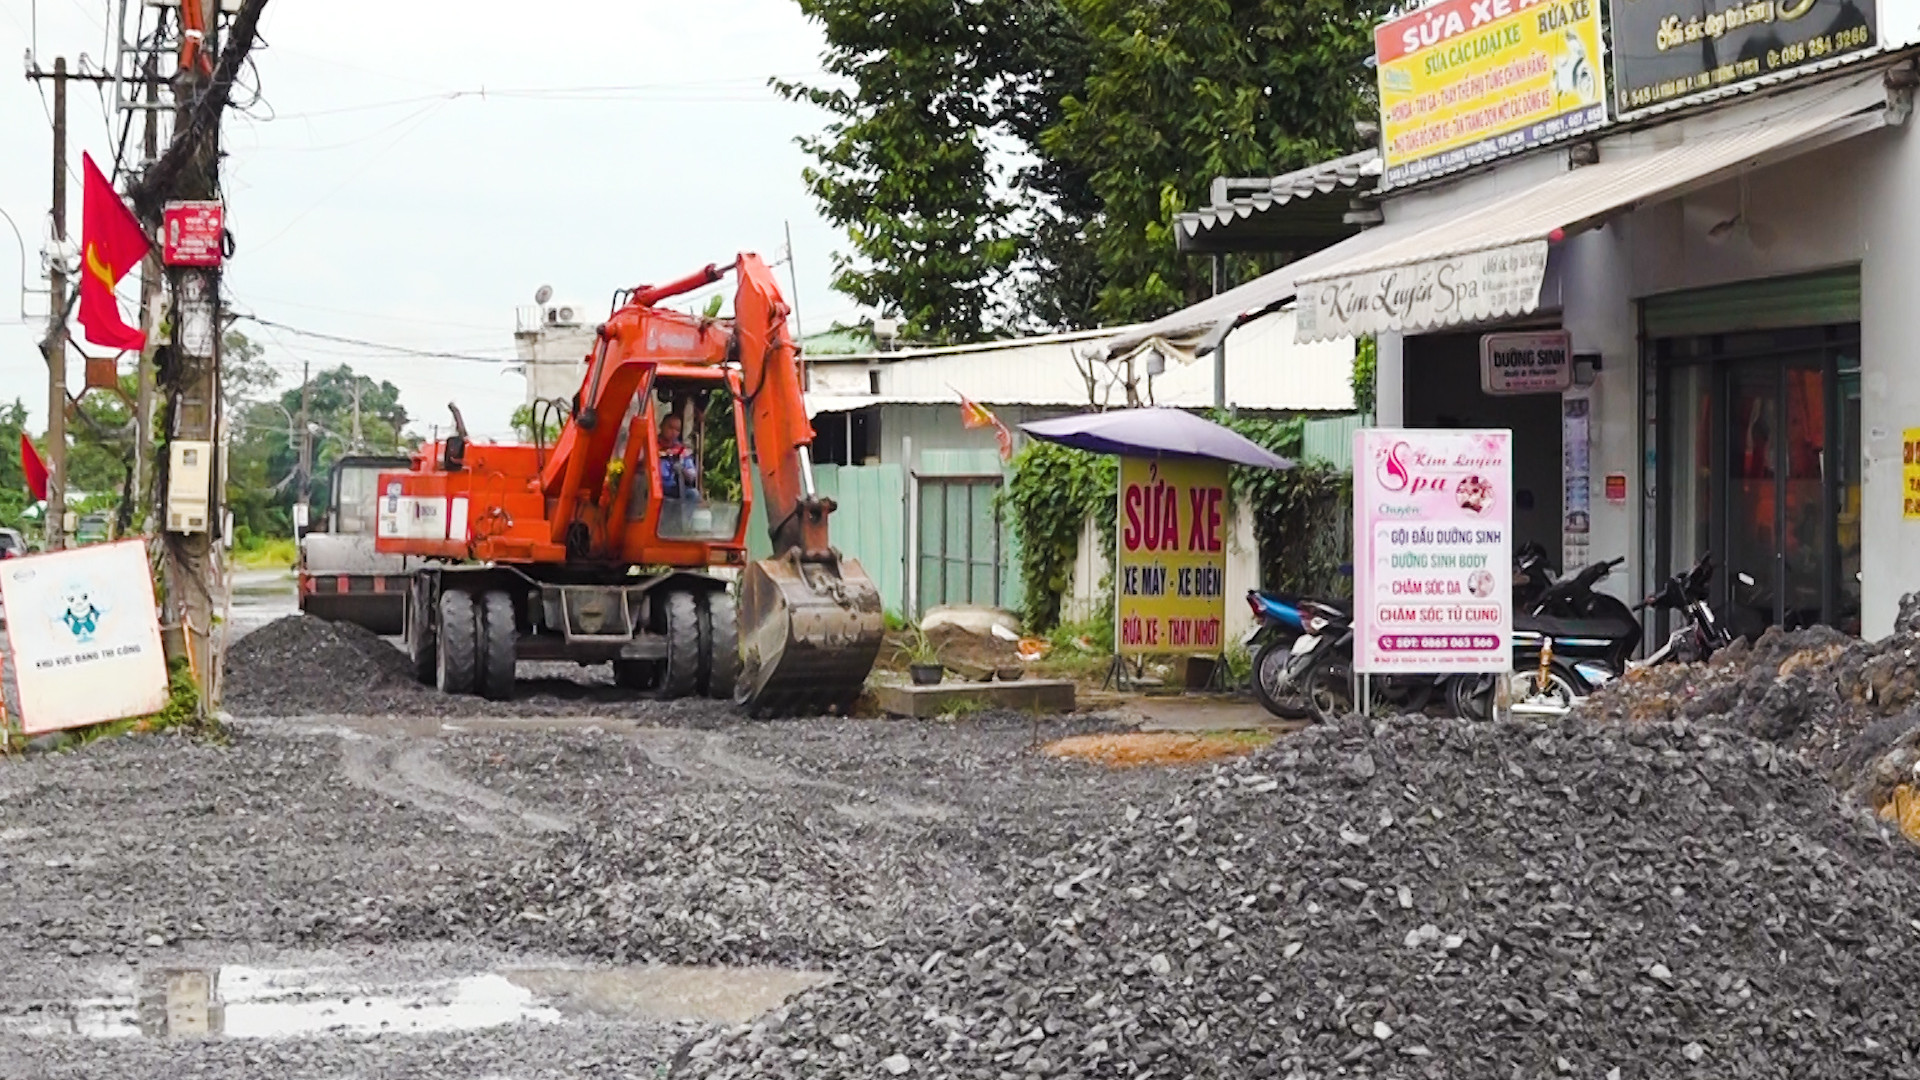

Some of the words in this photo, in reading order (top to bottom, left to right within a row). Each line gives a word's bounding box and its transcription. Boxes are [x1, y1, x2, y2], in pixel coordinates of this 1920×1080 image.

[1403, 11, 1465, 53] SỬA
[1470, 0, 1512, 27] XE
[1538, 2, 1568, 35] RỬA
[1570, 0, 1590, 23] XE
[1425, 47, 1449, 76] SỬA
[1449, 39, 1471, 67] CÁC
[1473, 28, 1502, 58] LOẠI
[1504, 22, 1520, 47] XE
[1781, 42, 1805, 65] 086
[1808, 33, 1832, 58] 284
[1320, 283, 1370, 323] Kim
[1372, 270, 1433, 319] Luyến
[1434, 260, 1479, 313] Spa
[1537, 348, 1566, 366] SINH
[1414, 453, 1448, 467] Kim
[1124, 462, 1179, 551] SỬA
[1188, 486, 1223, 551] XE
[1391, 528, 1409, 546] GỘI
[1437, 525, 1473, 544] DƯỠNG
[1476, 530, 1502, 544] SINH
[1391, 551, 1428, 568] DƯỠNG
[1430, 553, 1456, 568] SINH
[1459, 553, 1488, 568] BODY
[1124, 566, 1138, 596] XE
[1142, 560, 1167, 596] MÁY
[1177, 566, 1192, 596] XE
[1195, 561, 1221, 605] ĐIỆN
[1392, 578, 1422, 595] CHĂM
[1424, 578, 1445, 595] SÓC
[1447, 580, 1461, 594] DA
[1123, 608, 1143, 645] RỬA
[1145, 616, 1158, 645] XE
[1168, 616, 1192, 645] THAY
[1195, 612, 1221, 645] NHỚT
[1380, 606, 1416, 623] CHĂM
[1419, 605, 1444, 622] SÓC
[1448, 602, 1463, 622] TỬ
[1465, 608, 1499, 622] CUNG
[36, 659, 54, 669] KHU
[101, 648, 114, 659] THI
[117, 644, 141, 656] CÔNG
